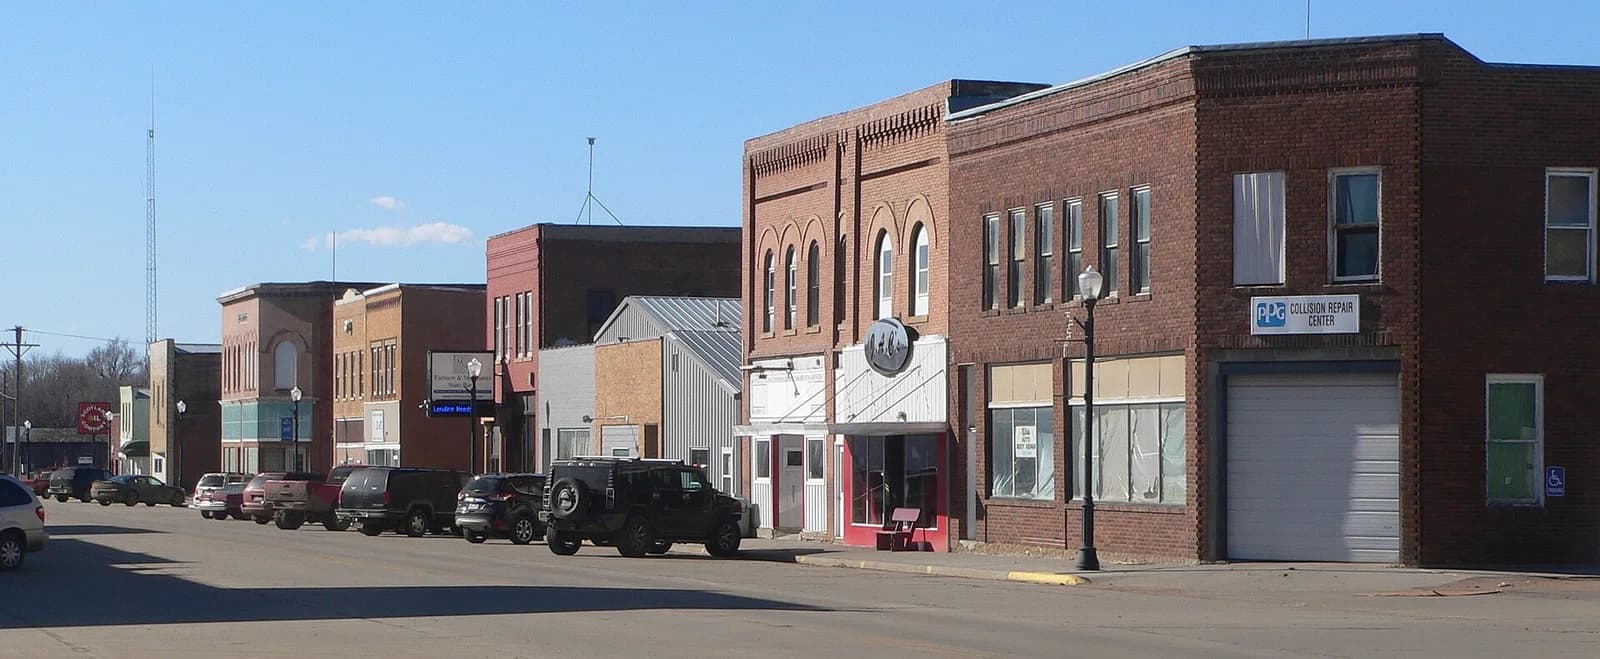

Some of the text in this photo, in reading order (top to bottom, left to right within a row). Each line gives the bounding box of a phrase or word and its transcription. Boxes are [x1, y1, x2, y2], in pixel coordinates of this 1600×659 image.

[1258, 302, 1285, 323] PPG
[1290, 301, 1353, 314] COLLISION REPAIR
[1308, 315, 1335, 327] CENTER
[81, 420, 106, 432] COMPANY
